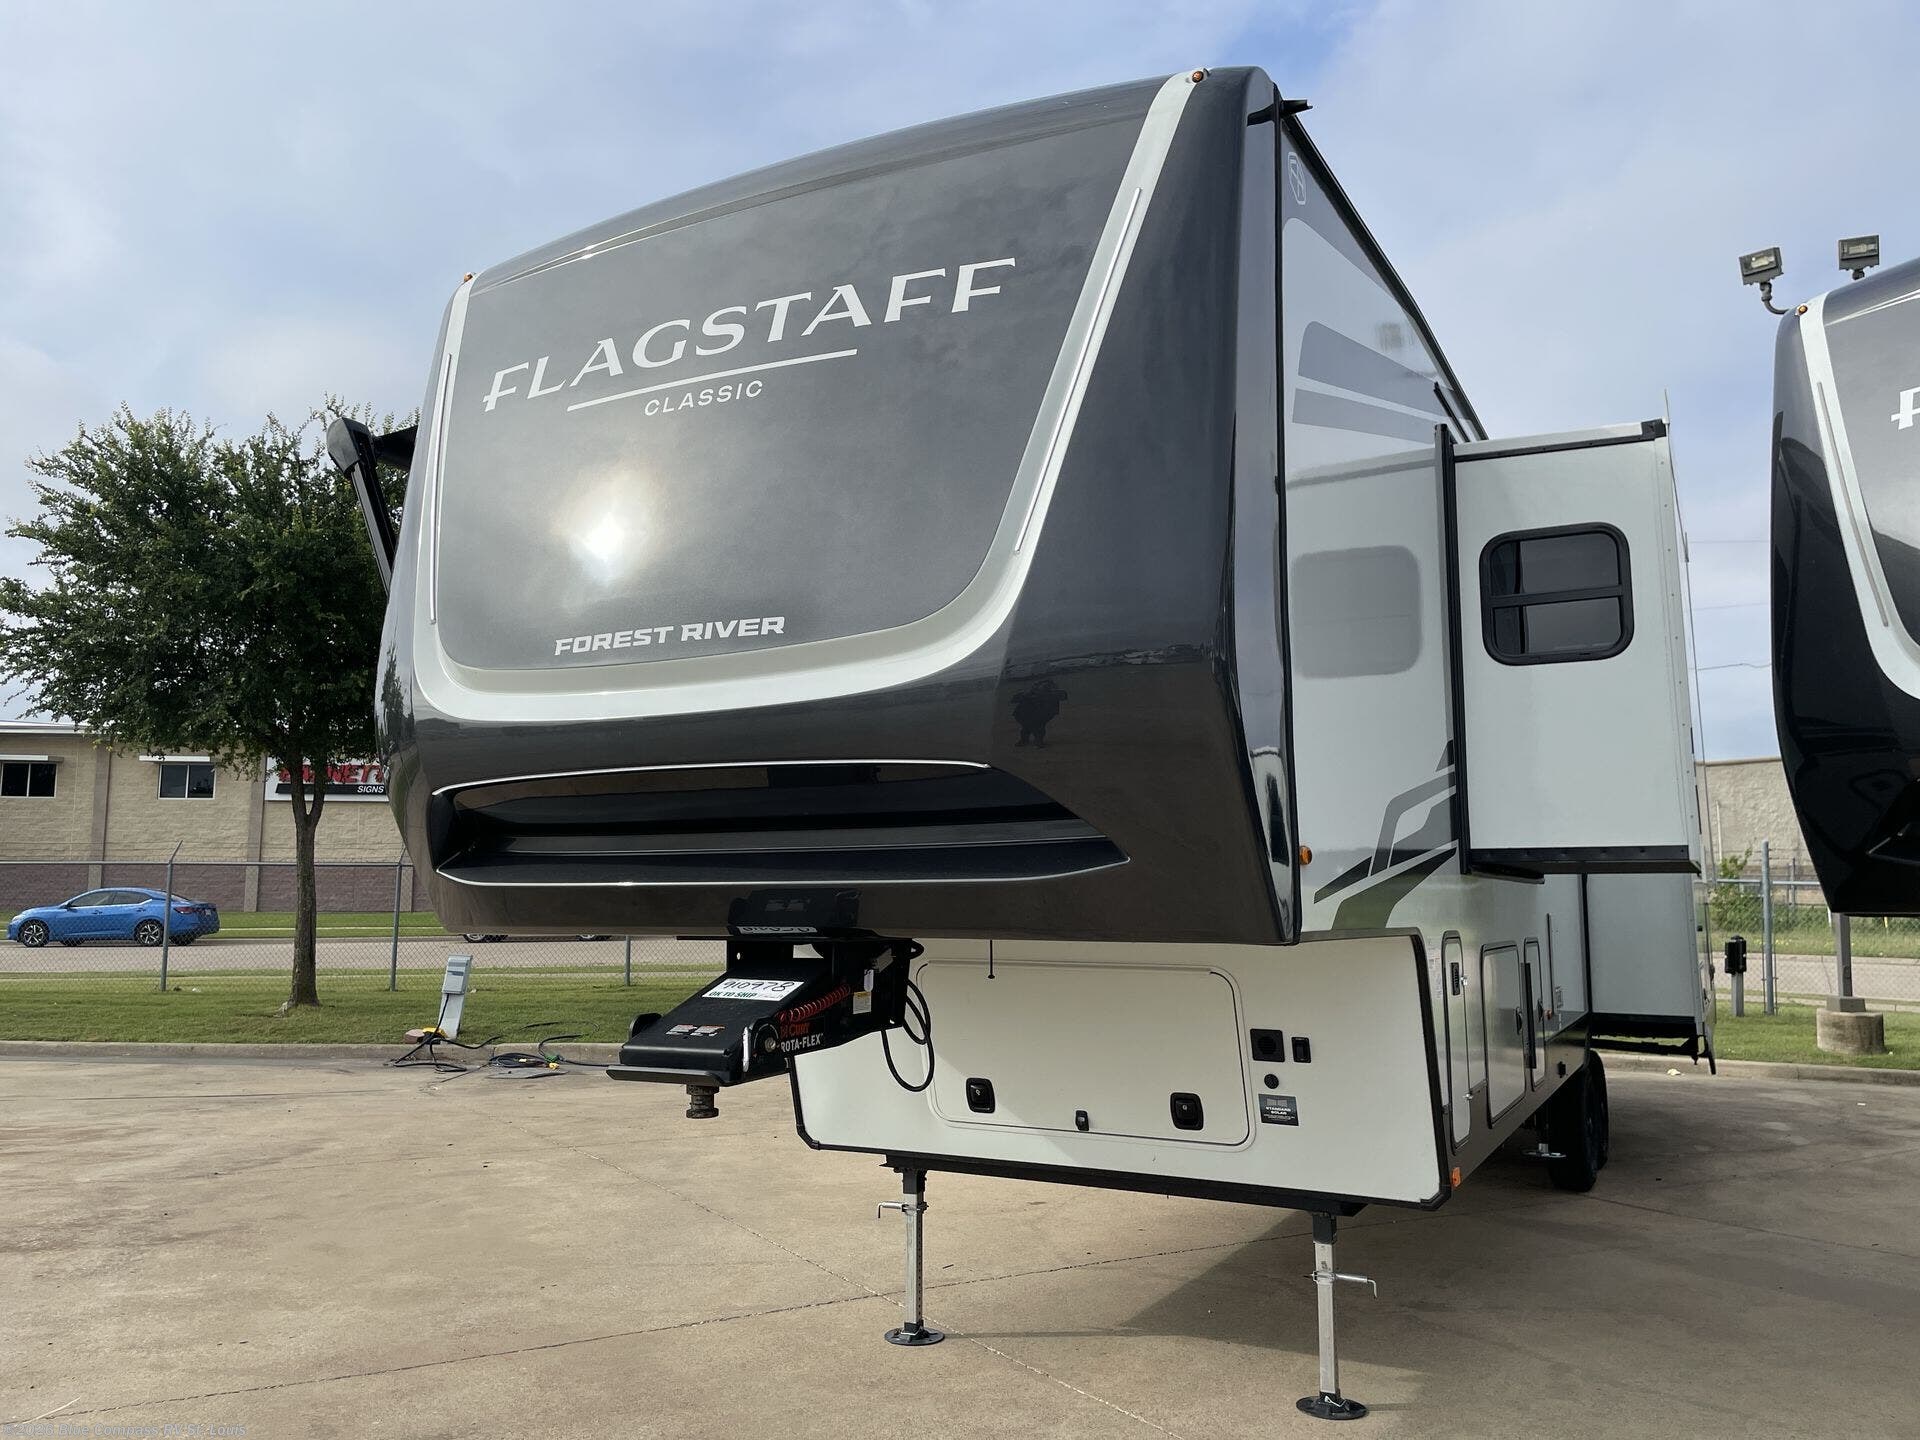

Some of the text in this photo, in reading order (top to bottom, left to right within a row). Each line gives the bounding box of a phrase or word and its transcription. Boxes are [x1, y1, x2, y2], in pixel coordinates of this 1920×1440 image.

[483, 257, 1017, 413] FLAGSTAFF
[643, 379, 763, 417] CLASSIC
[554, 616, 786, 656] FOREST RIVER
[357, 785, 384, 793] SIGNS
